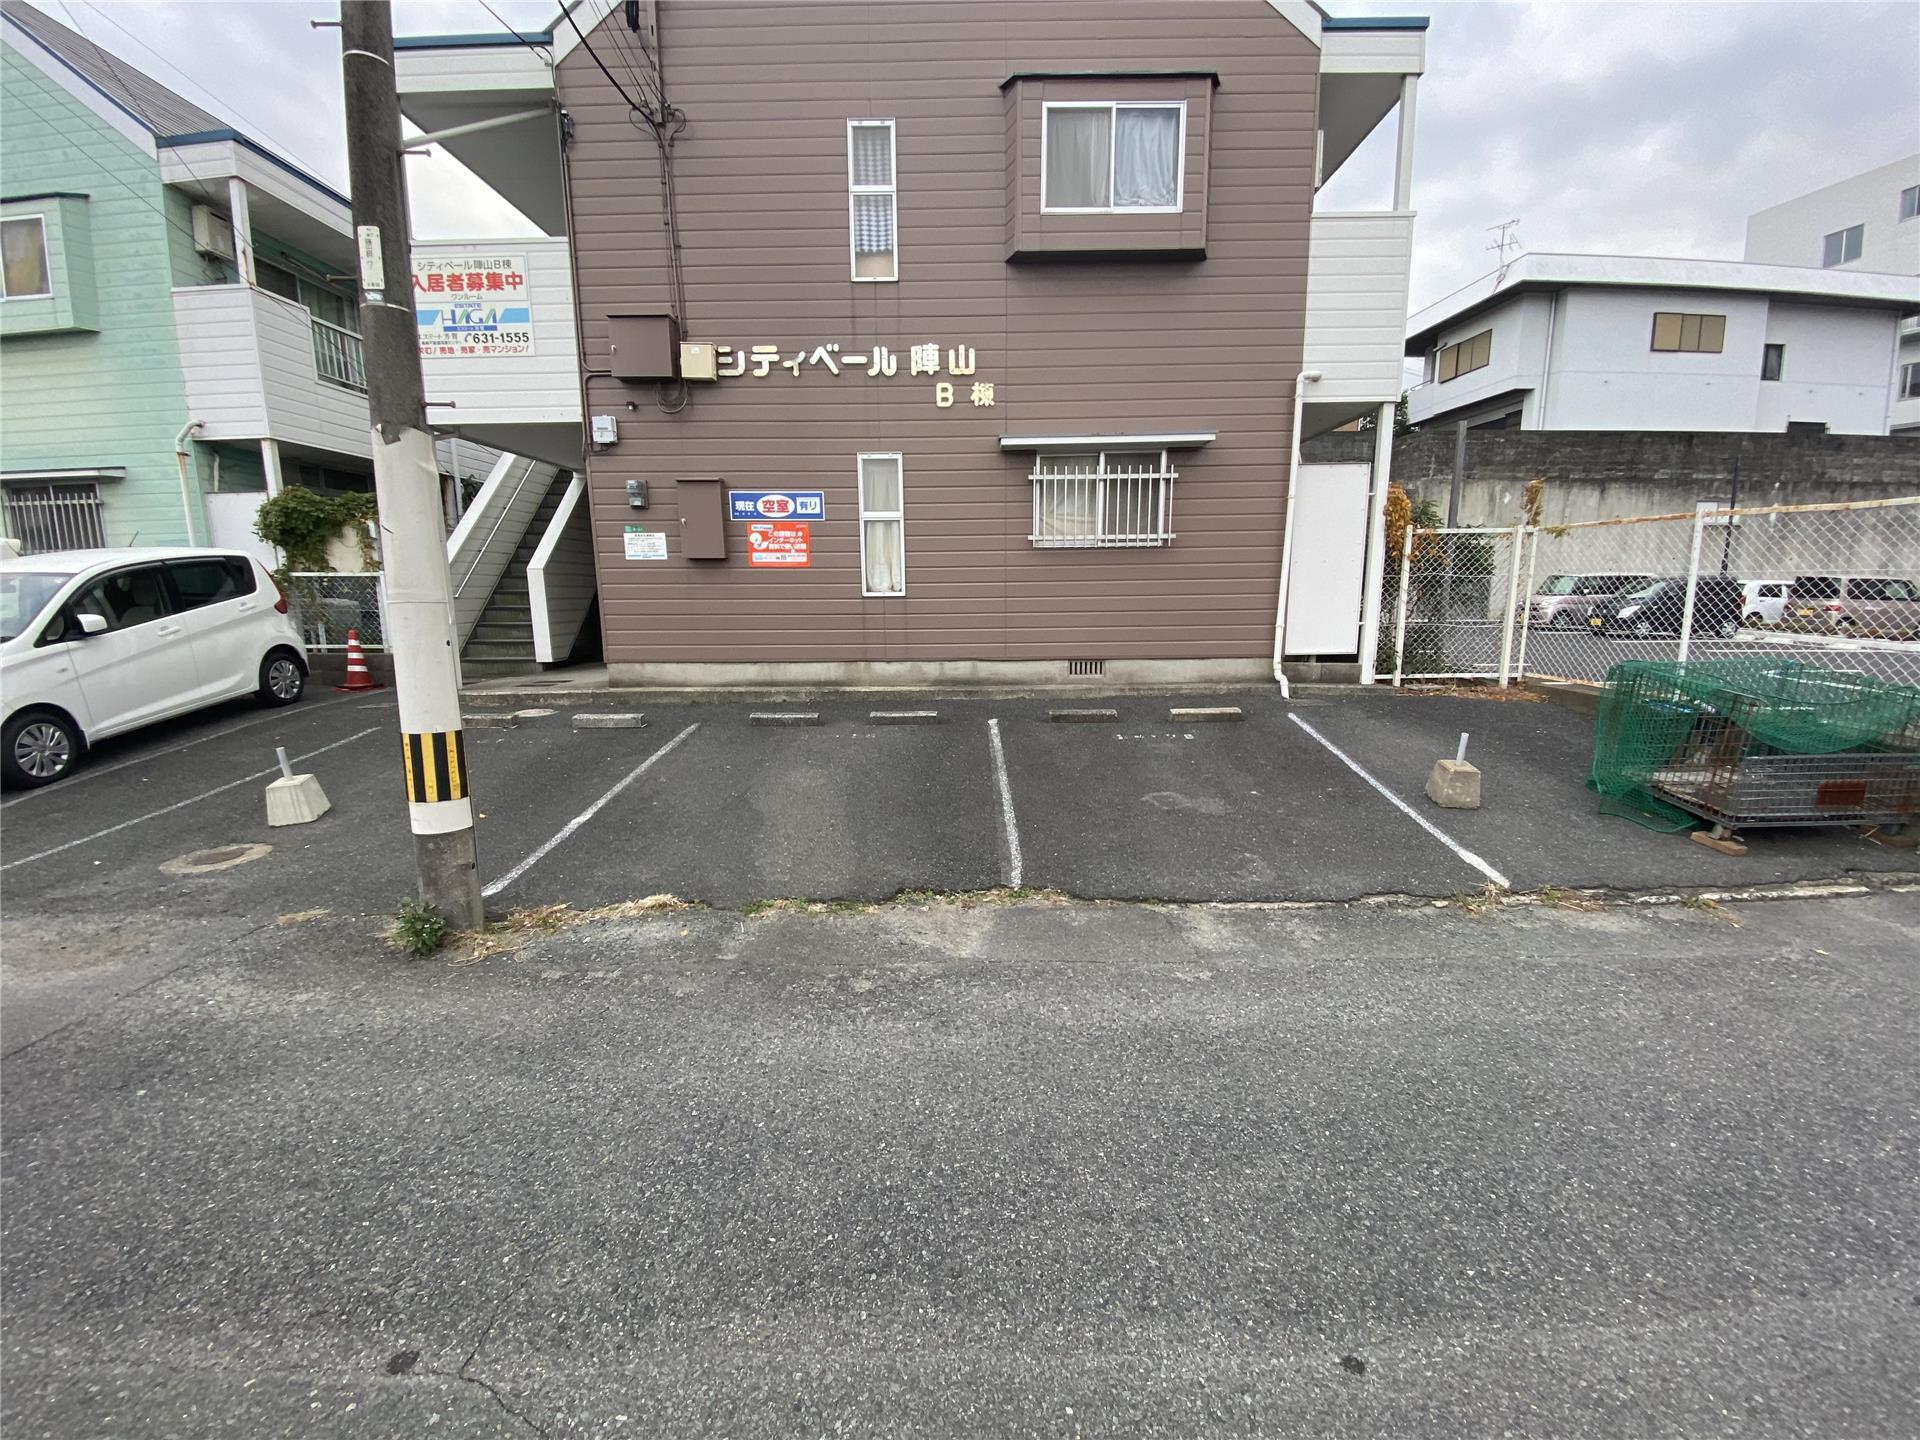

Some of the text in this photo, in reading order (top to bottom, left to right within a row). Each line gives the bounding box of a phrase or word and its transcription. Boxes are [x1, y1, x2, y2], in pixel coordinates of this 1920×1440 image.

[412, 271, 523, 293] 入居者募集中
[441, 308, 497, 324] HAGA
[473, 332, 529, 344] 631-1555
[735, 499, 817, 513] 現在 空室 有り
